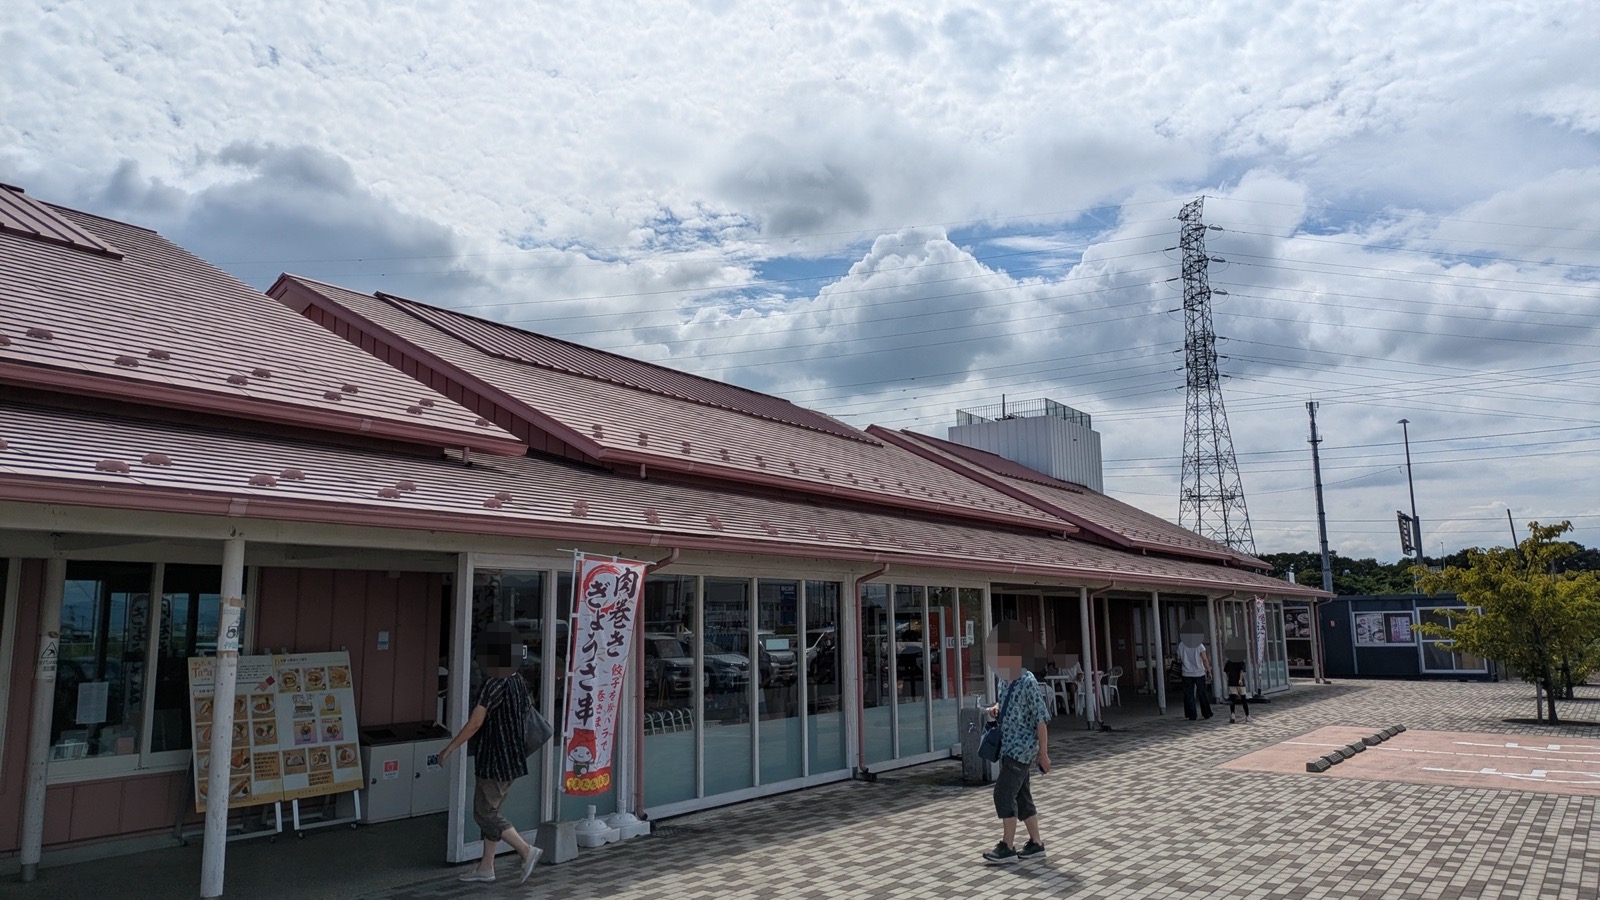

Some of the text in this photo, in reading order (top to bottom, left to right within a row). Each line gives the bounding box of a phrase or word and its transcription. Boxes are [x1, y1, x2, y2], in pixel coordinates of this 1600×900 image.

[606, 567, 639, 658] 肉巻き
[948, 639, 967, 647] LOTE
